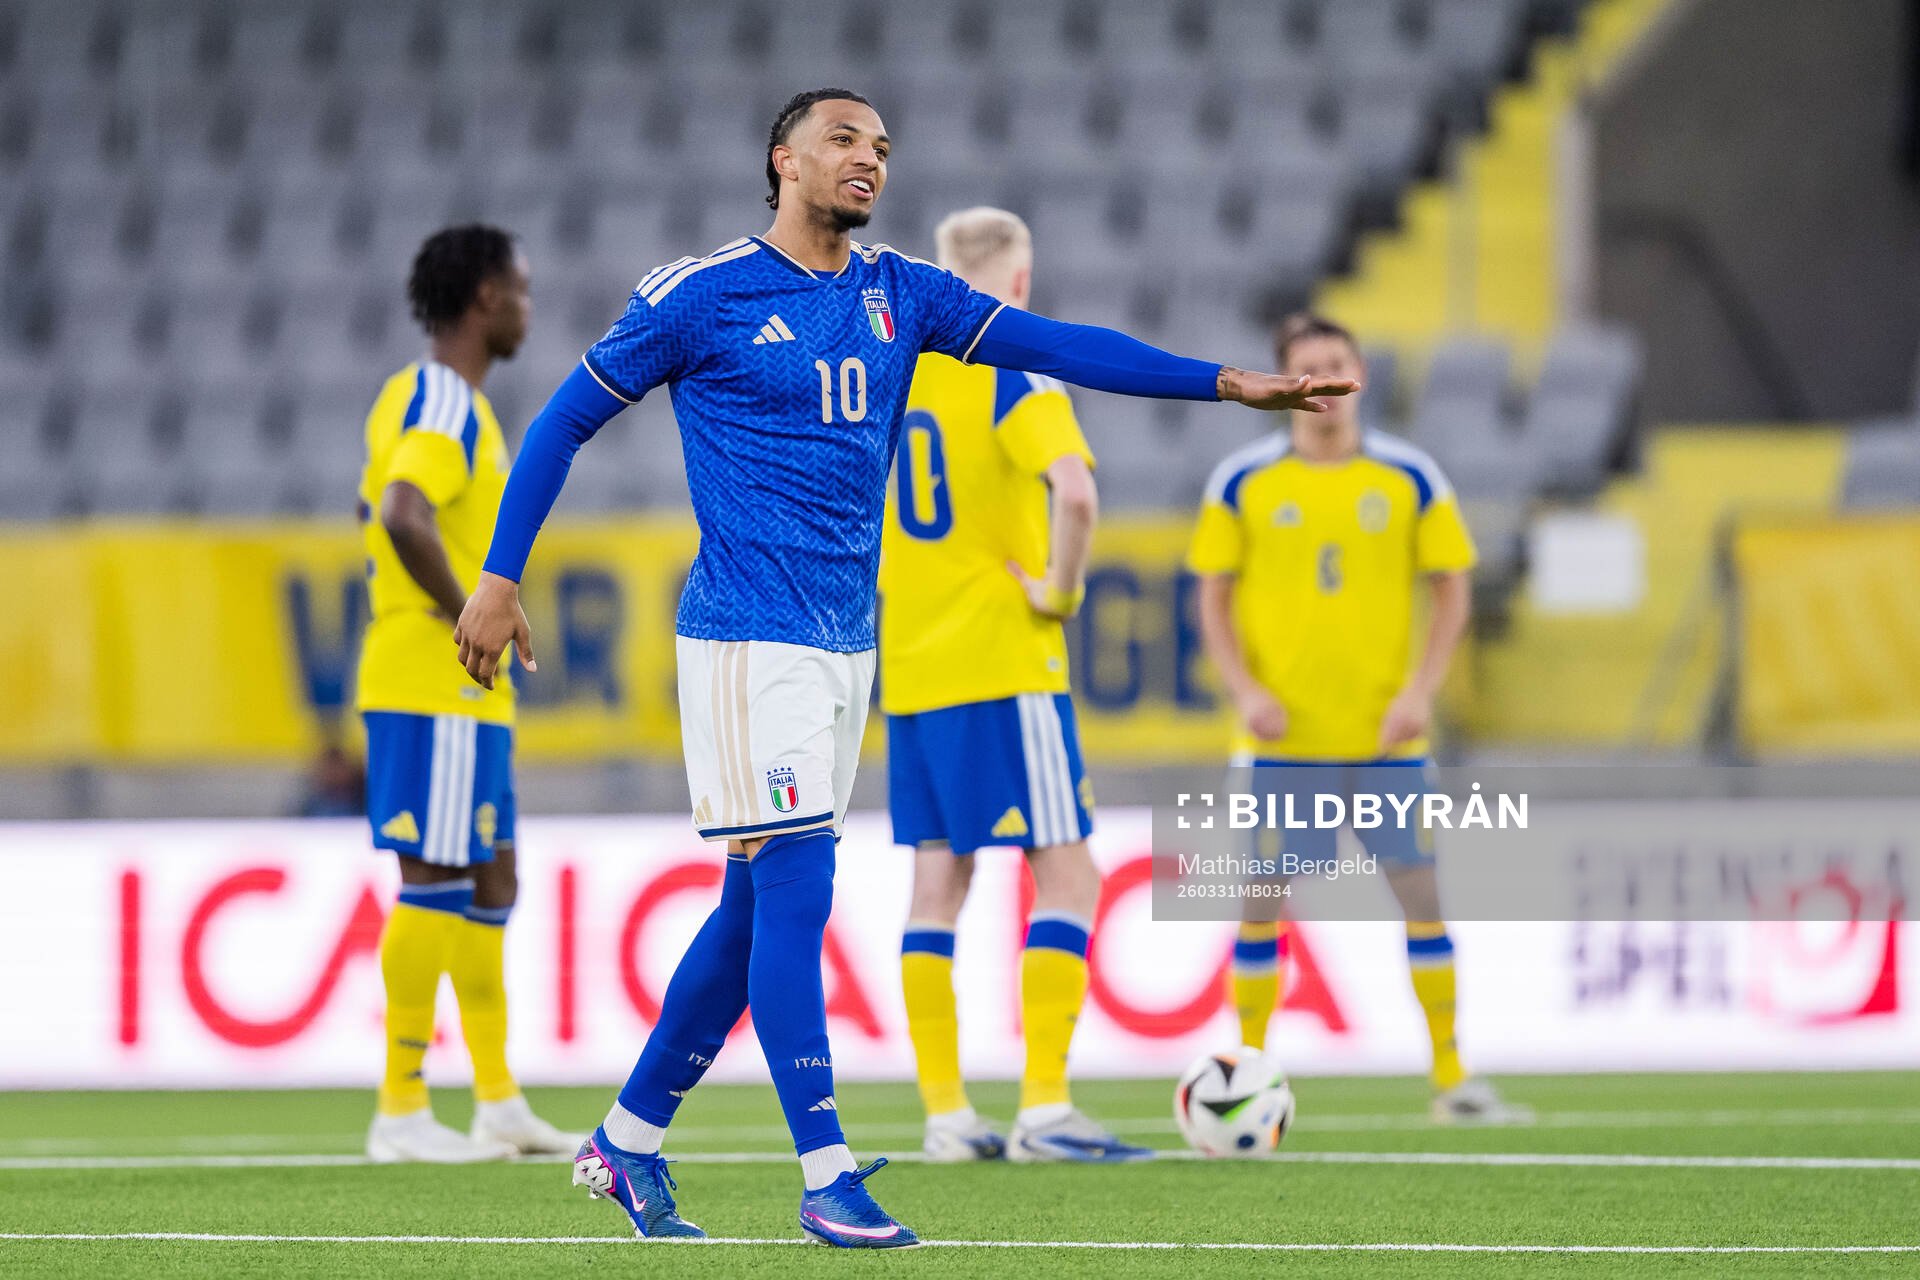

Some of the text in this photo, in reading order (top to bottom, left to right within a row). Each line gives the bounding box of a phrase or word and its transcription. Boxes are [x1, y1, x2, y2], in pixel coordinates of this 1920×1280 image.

[866, 300, 887, 309] ITALIA
[815, 357, 867, 423] 10
[770, 775, 793, 786] ITALIA
